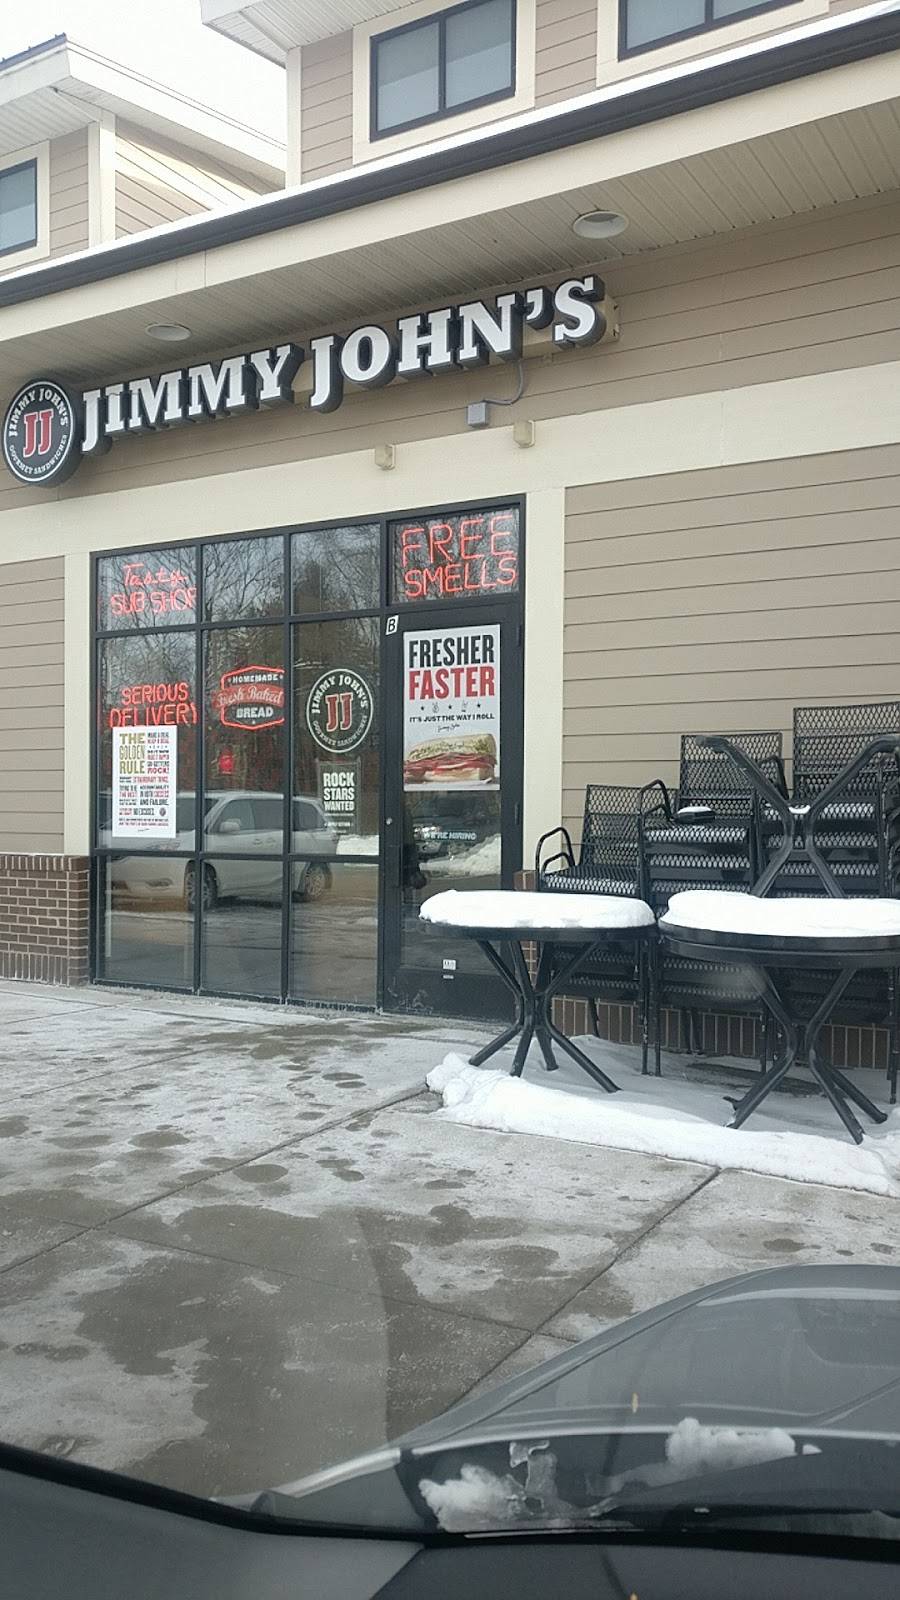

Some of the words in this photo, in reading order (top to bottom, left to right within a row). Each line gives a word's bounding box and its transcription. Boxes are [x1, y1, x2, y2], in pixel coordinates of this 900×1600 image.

[81, 344, 292, 452] JIMMY
[310, 275, 599, 408] JOHN'S
[8, 389, 36, 437] JIMMY
[39, 388, 69, 427] JOHN'S
[23, 408, 54, 458] JJ
[402, 514, 514, 568] FREE
[404, 557, 517, 597] SMELLS
[110, 591, 145, 615] SUB
[388, 618, 396, 633] B
[409, 634, 495, 668] FRESHER
[232, 674, 279, 683] HOMEMADE
[409, 666, 495, 700] FASTER
[121, 682, 190, 705] SERIOUS
[247, 685, 284, 704] Baked
[311, 675, 336, 714] JIMMY
[338, 674, 369, 709] JOHN'S
[236, 706, 274, 719] BREAD
[325, 692, 354, 732] JJ
[119, 732, 145, 745] THE
[119, 745, 145, 760] GOLDEN
[119, 760, 145, 774] RULE
[323, 772, 355, 787] ROCK
[323, 787, 355, 801] STARS
[323, 801, 355, 811] WANTED
[448, 832, 477, 840] HIRING
